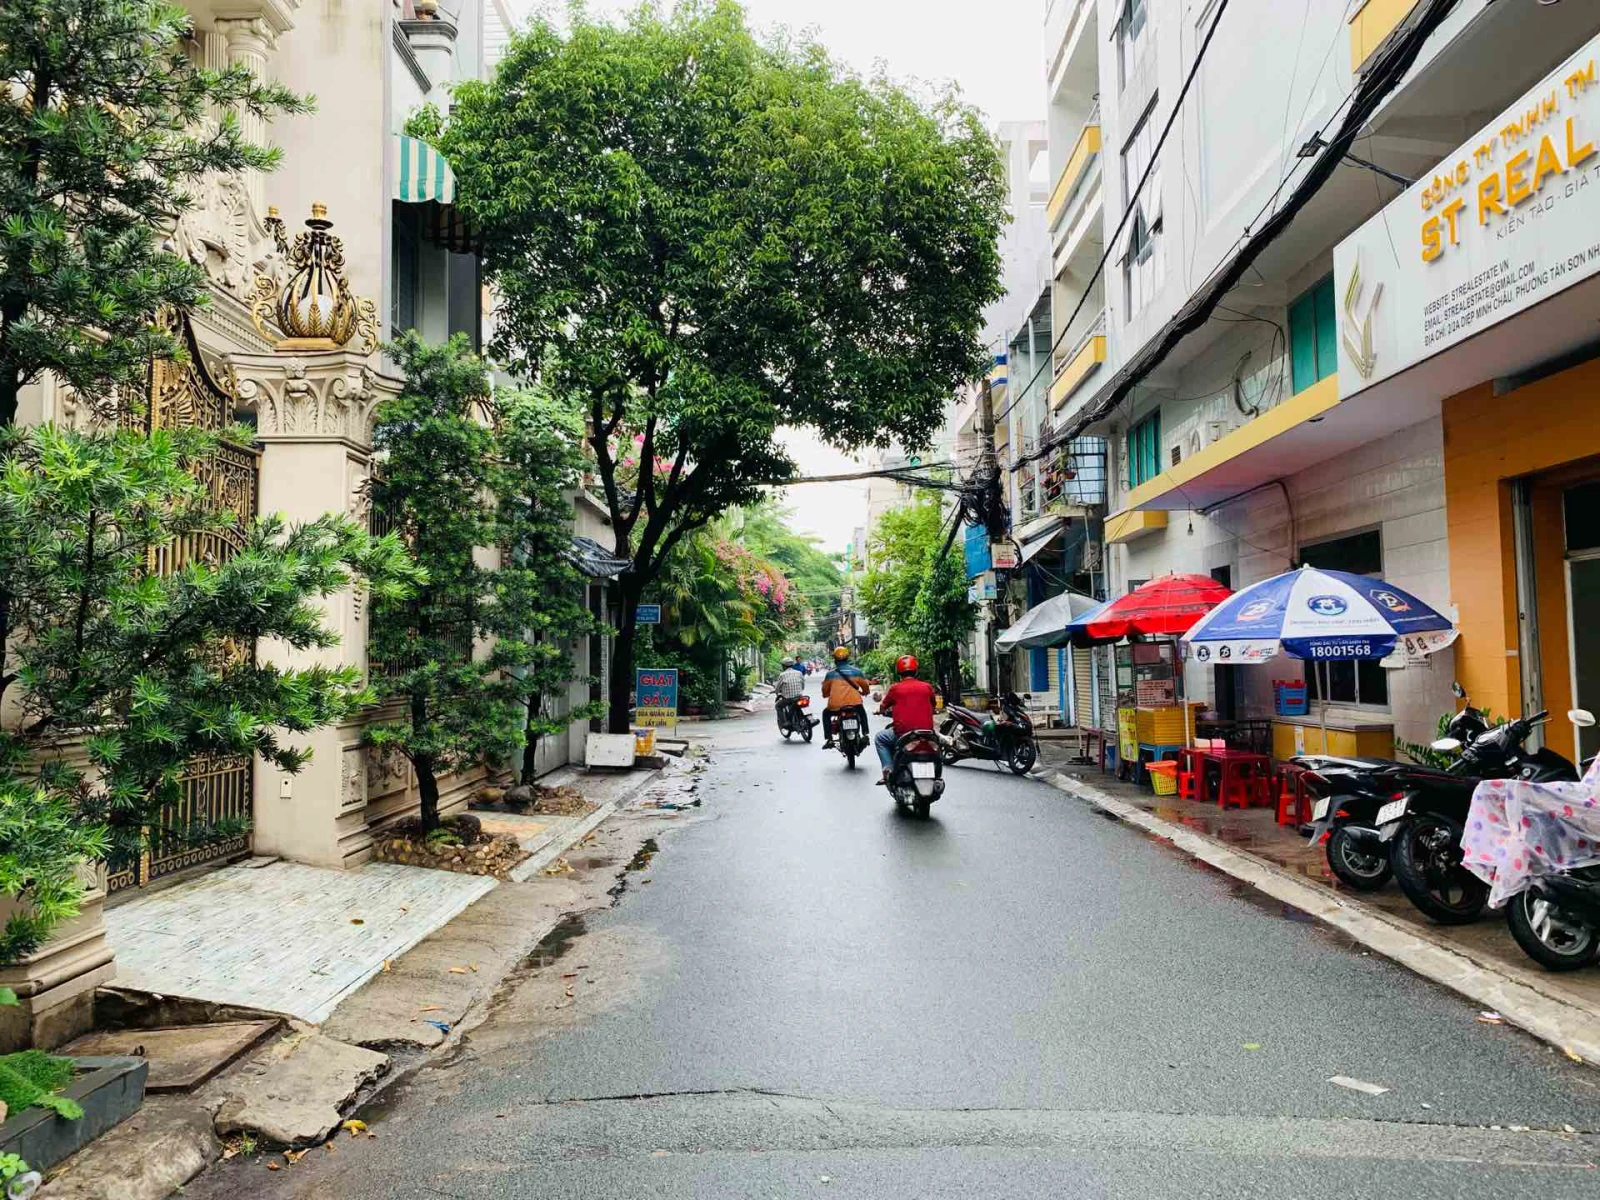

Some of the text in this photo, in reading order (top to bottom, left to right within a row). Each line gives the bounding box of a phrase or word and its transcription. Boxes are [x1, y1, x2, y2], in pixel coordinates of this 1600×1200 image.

[1473, 137, 1495, 168] TY
[1500, 90, 1557, 148] TNHH
[1421, 116, 1595, 262] ST REAL
[1444, 261, 1536, 321] STREALESTATE@GMAIL.COM
[1476, 302, 1492, 319] MINH
[1310, 645, 1371, 657] 18001568
